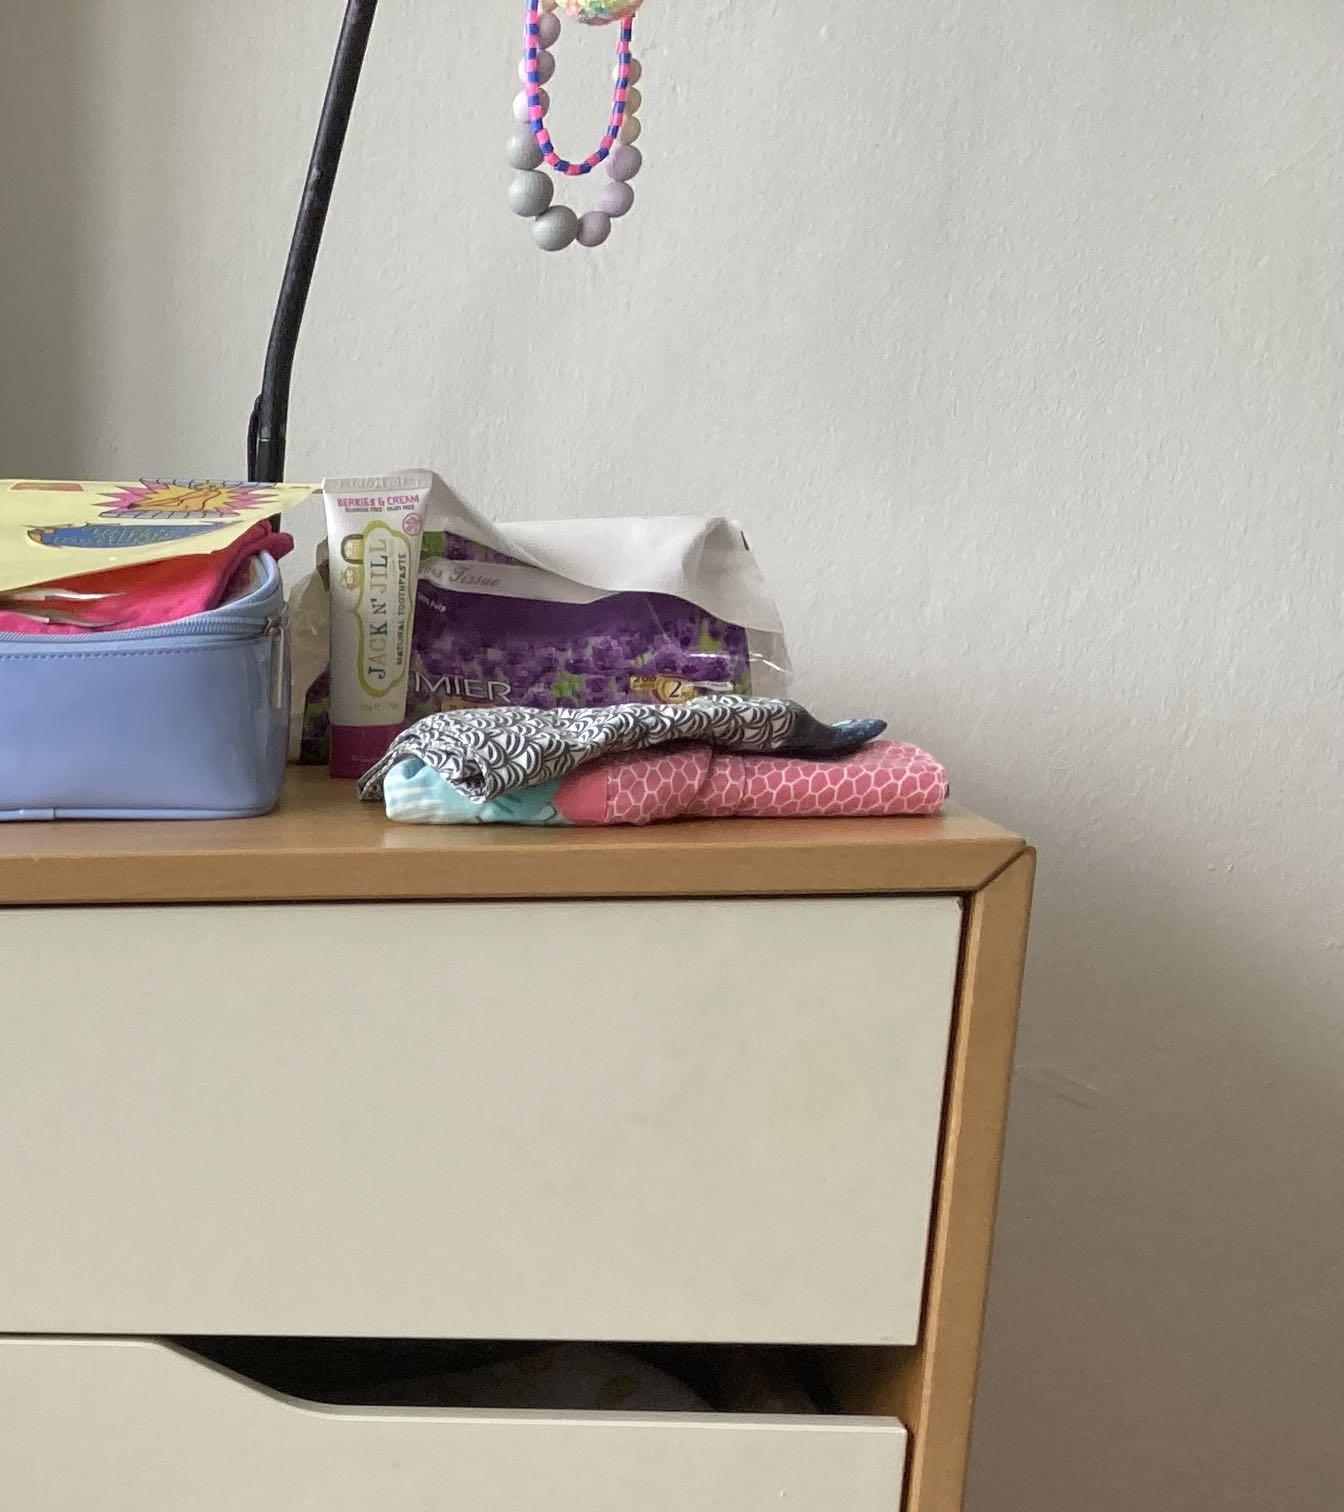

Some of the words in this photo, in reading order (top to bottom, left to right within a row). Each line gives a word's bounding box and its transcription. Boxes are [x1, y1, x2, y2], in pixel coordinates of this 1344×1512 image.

[337, 498, 375, 507] BERRIES
[387, 494, 420, 505] CREAM
[368, 537, 388, 595] JILL
[398, 552, 407, 616] TOOTHPASTE
[448, 566, 501, 587] Tissue
[368, 621, 388, 680] JACK
[396, 619, 405, 666] NATURAL
